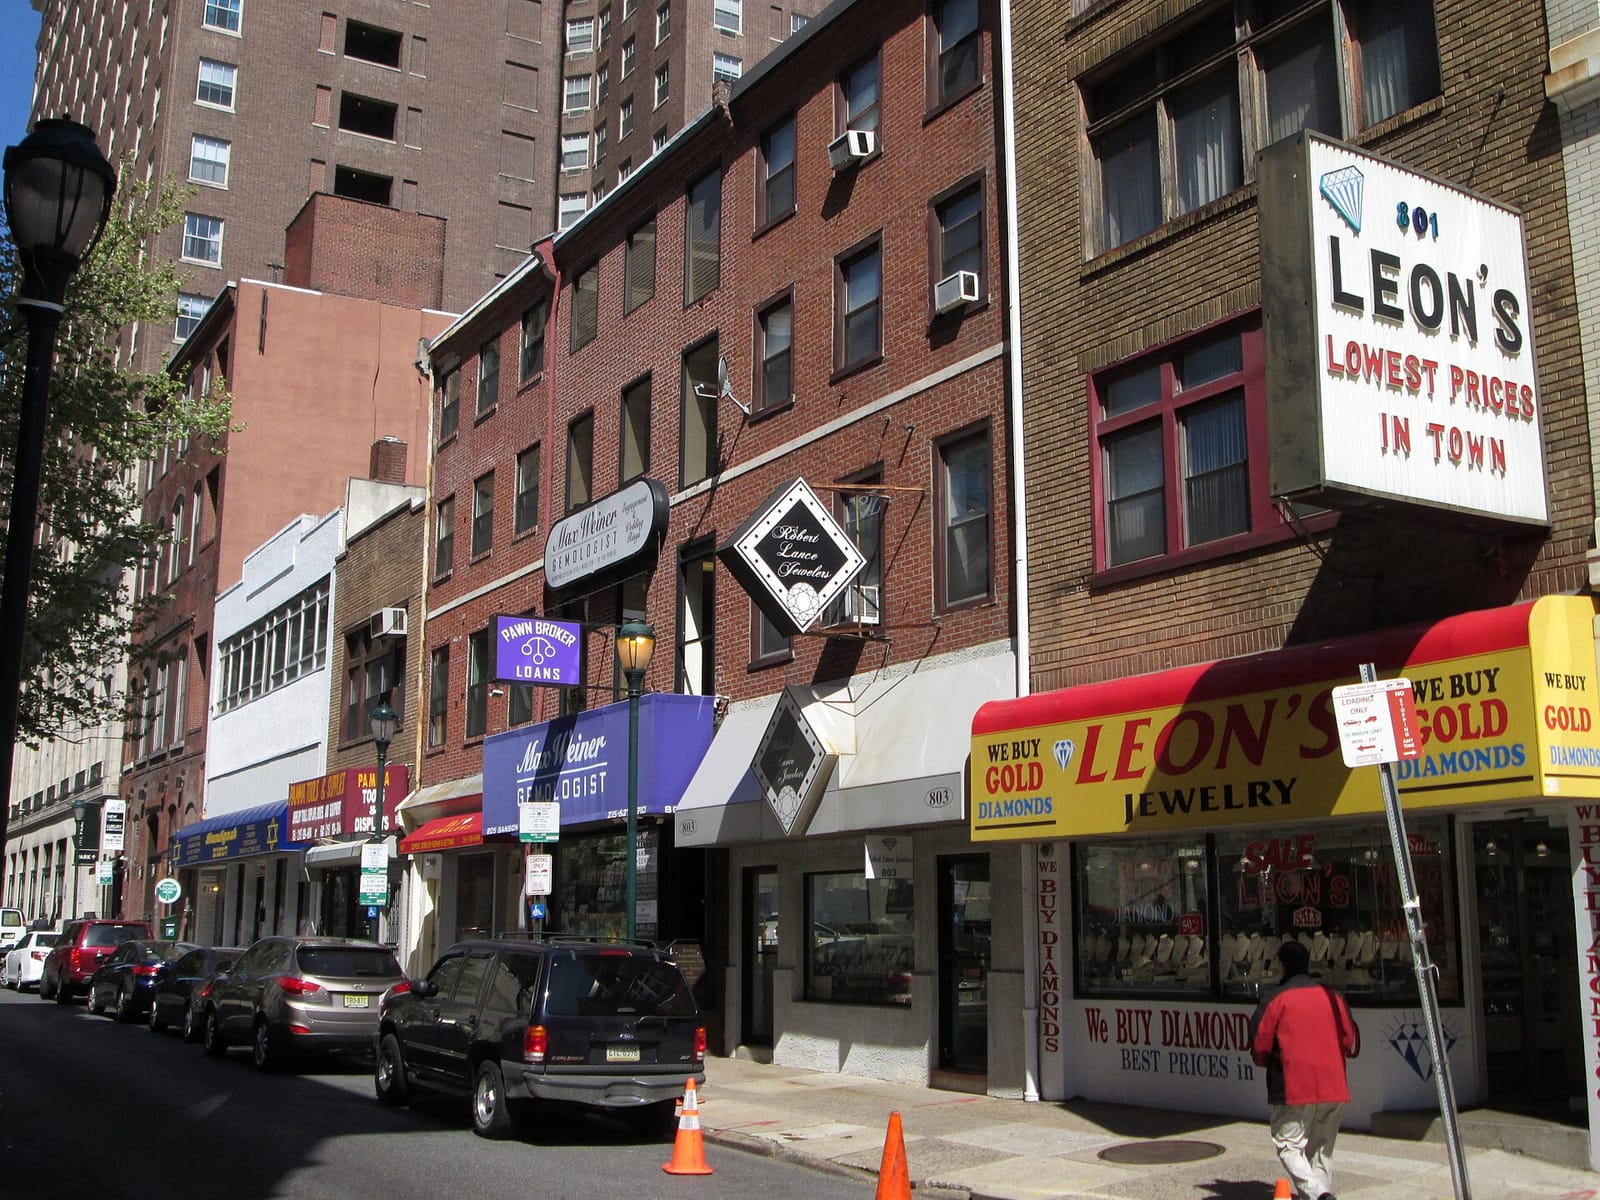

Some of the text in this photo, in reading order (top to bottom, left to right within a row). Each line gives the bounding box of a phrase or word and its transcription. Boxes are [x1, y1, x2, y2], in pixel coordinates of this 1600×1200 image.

[1397, 201, 1438, 238] 801
[1328, 235, 1523, 353] LEON'S
[1326, 334, 1534, 418] LOWEST PRICES
[1379, 412, 1507, 473] IN TOWN
[552, 509, 618, 551] Max Weiner
[772, 524, 820, 544] Robert
[551, 530, 618, 573] GEMOLOGIST
[776, 541, 819, 562] Lance
[777, 562, 831, 579] Jewelers
[501, 621, 576, 648] PAWN BROKER
[516, 665, 560, 681] LOANS
[1410, 668, 1501, 704] WE BUY
[1545, 672, 1587, 692] WE BUY
[1342, 695, 1374, 706] LOADING
[1350, 706, 1368, 715] ONLY
[1416, 698, 1509, 744] GOLD
[1544, 704, 1592, 733] GOLD
[517, 728, 607, 774] Max Weiner
[987, 738, 1041, 762] WE BUY
[1075, 688, 1339, 785] LEON'S
[1397, 743, 1527, 780] DIAMONDS
[1551, 746, 1600, 768] DIAMONDS
[358, 771, 390, 788] PAMA
[517, 771, 607, 807] GEMOLOGIST
[985, 761, 1044, 795] GOLD
[362, 789, 386, 804] TOOS
[369, 805, 377, 815] &
[929, 789, 949, 805] 803
[978, 796, 1053, 820] DIAMONDS
[1124, 777, 1297, 826] JEWELRY
[355, 816, 389, 832] DISPLYS
[682, 821, 695, 833] 803
[1039, 861, 1057, 873] WE
[1244, 833, 1317, 876] SALE
[881, 868, 897, 877] 803
[1040, 879, 1057, 924] BUY
[1041, 931, 1060, 1052] DIAMONDS
[1085, 1008, 1251, 1052] We BUY DIAMOND
[1121, 1048, 1254, 1081] BEST PRICES in
